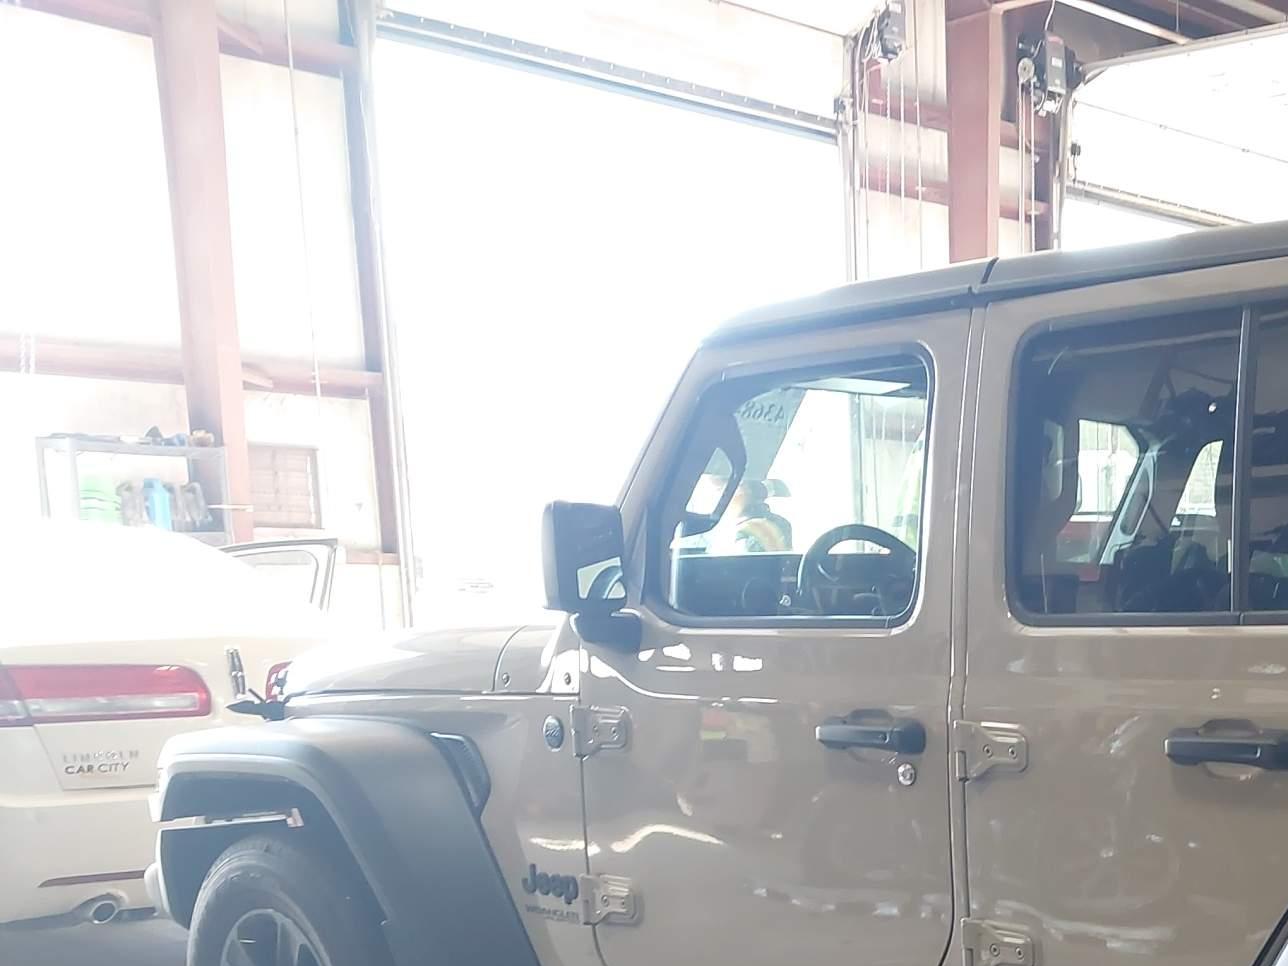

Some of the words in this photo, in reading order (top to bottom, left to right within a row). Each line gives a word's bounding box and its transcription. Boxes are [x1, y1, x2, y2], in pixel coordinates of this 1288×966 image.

[64, 764, 94, 775] CAR
[97, 762, 130, 773] CITY
[521, 863, 579, 905] Jeep
